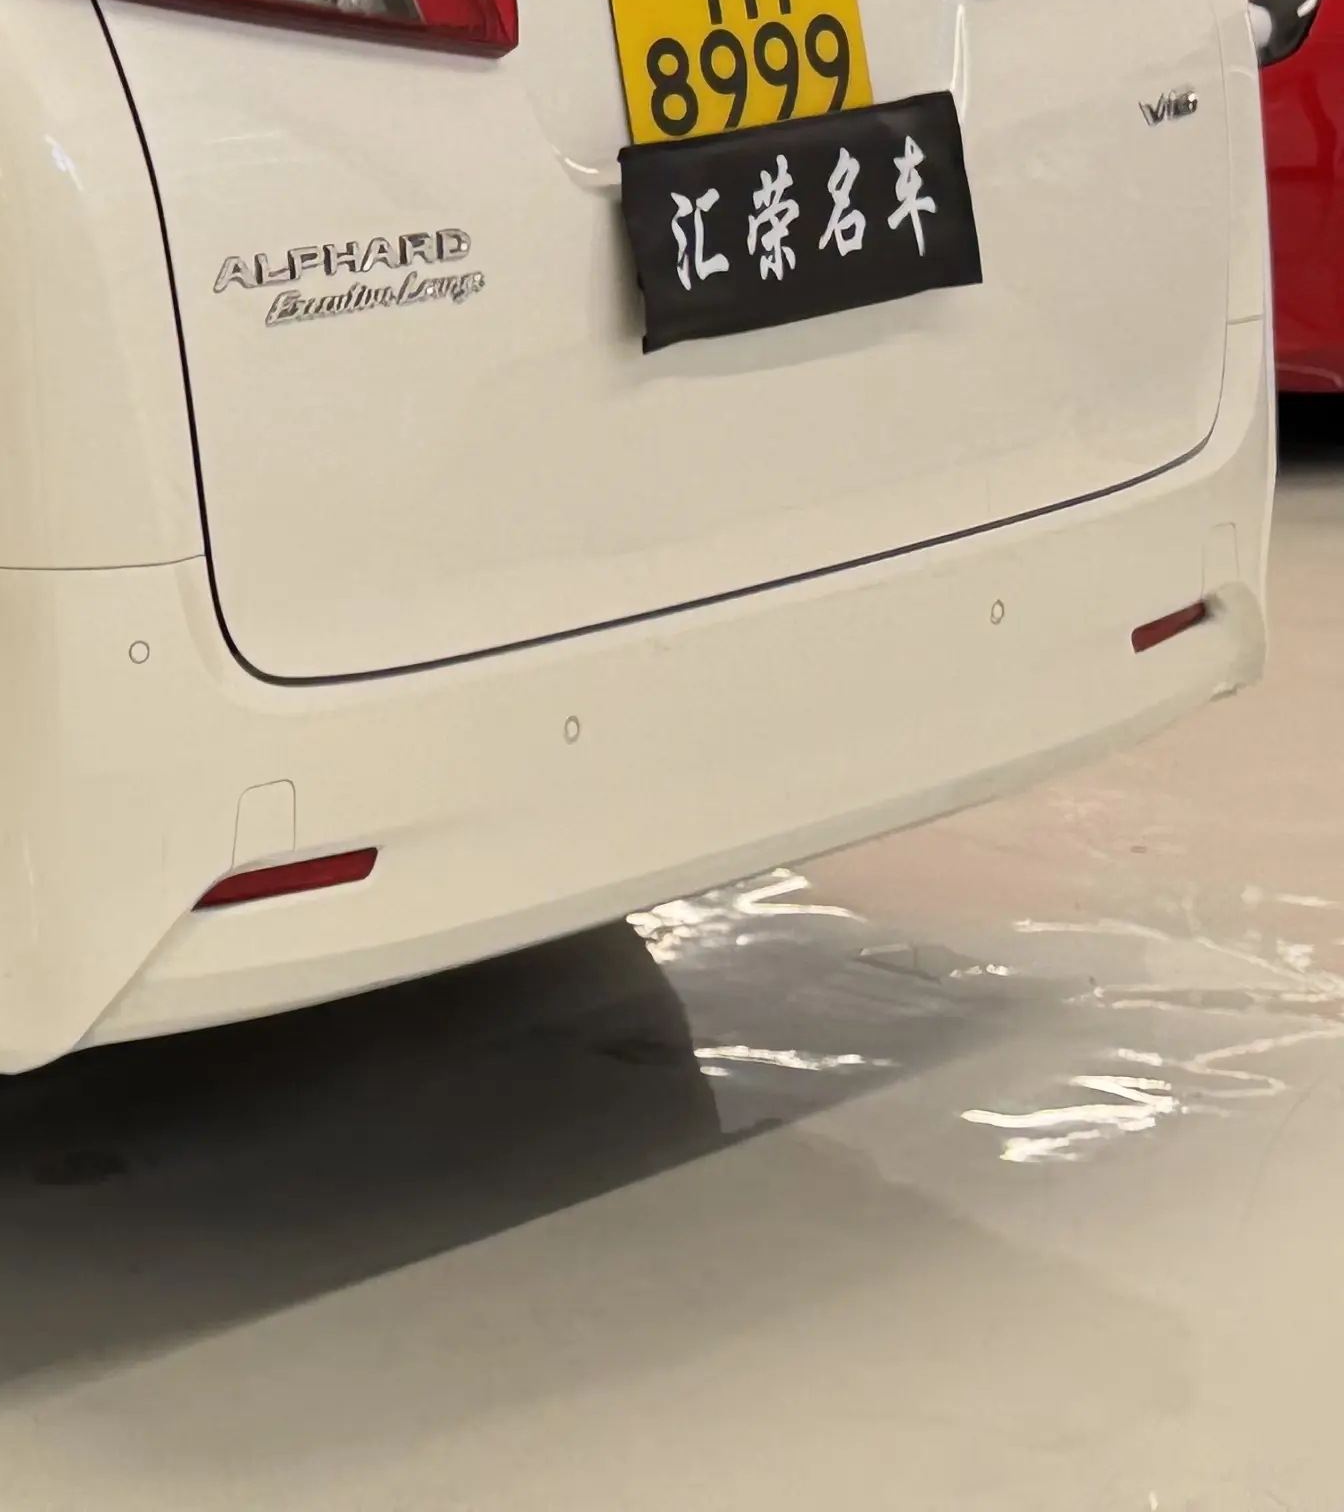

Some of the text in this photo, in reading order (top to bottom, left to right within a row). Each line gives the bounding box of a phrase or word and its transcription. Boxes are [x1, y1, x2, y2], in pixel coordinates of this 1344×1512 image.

[646, 13, 851, 137] 8999
[212, 227, 472, 294] ALPHARD
[670, 135, 938, 291] 汇荣名车
